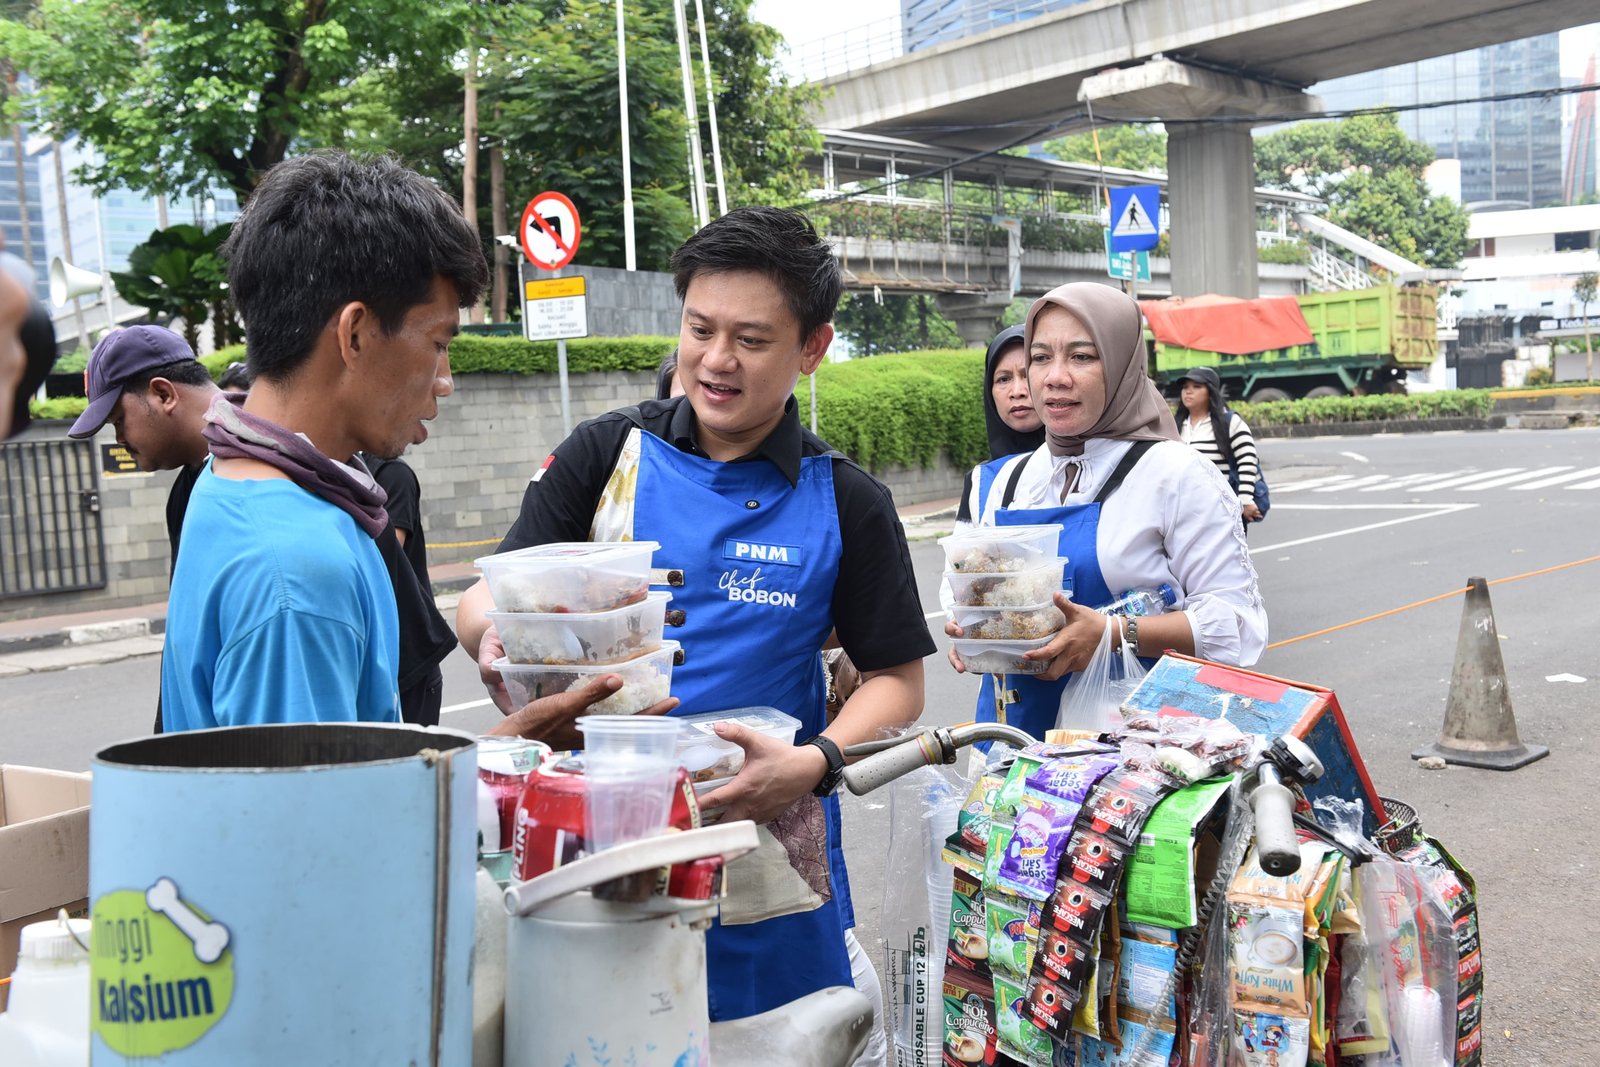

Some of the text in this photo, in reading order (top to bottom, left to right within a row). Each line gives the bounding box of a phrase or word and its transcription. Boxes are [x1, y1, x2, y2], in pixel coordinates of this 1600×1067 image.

[735, 542, 788, 562] PNM
[718, 567, 765, 590] Chef
[728, 587, 797, 608] BOBON
[1022, 859, 1041, 868] Sari
[953, 909, 986, 927] Cappuc
[971, 900, 986, 918] TO
[916, 962, 925, 975] 12
[916, 979, 925, 1004] CUP
[1262, 976, 1294, 993] White
[98, 974, 214, 1024] Kalsium
[963, 1002, 988, 1024] TOP
[945, 1013, 995, 1035] Cappuccino
